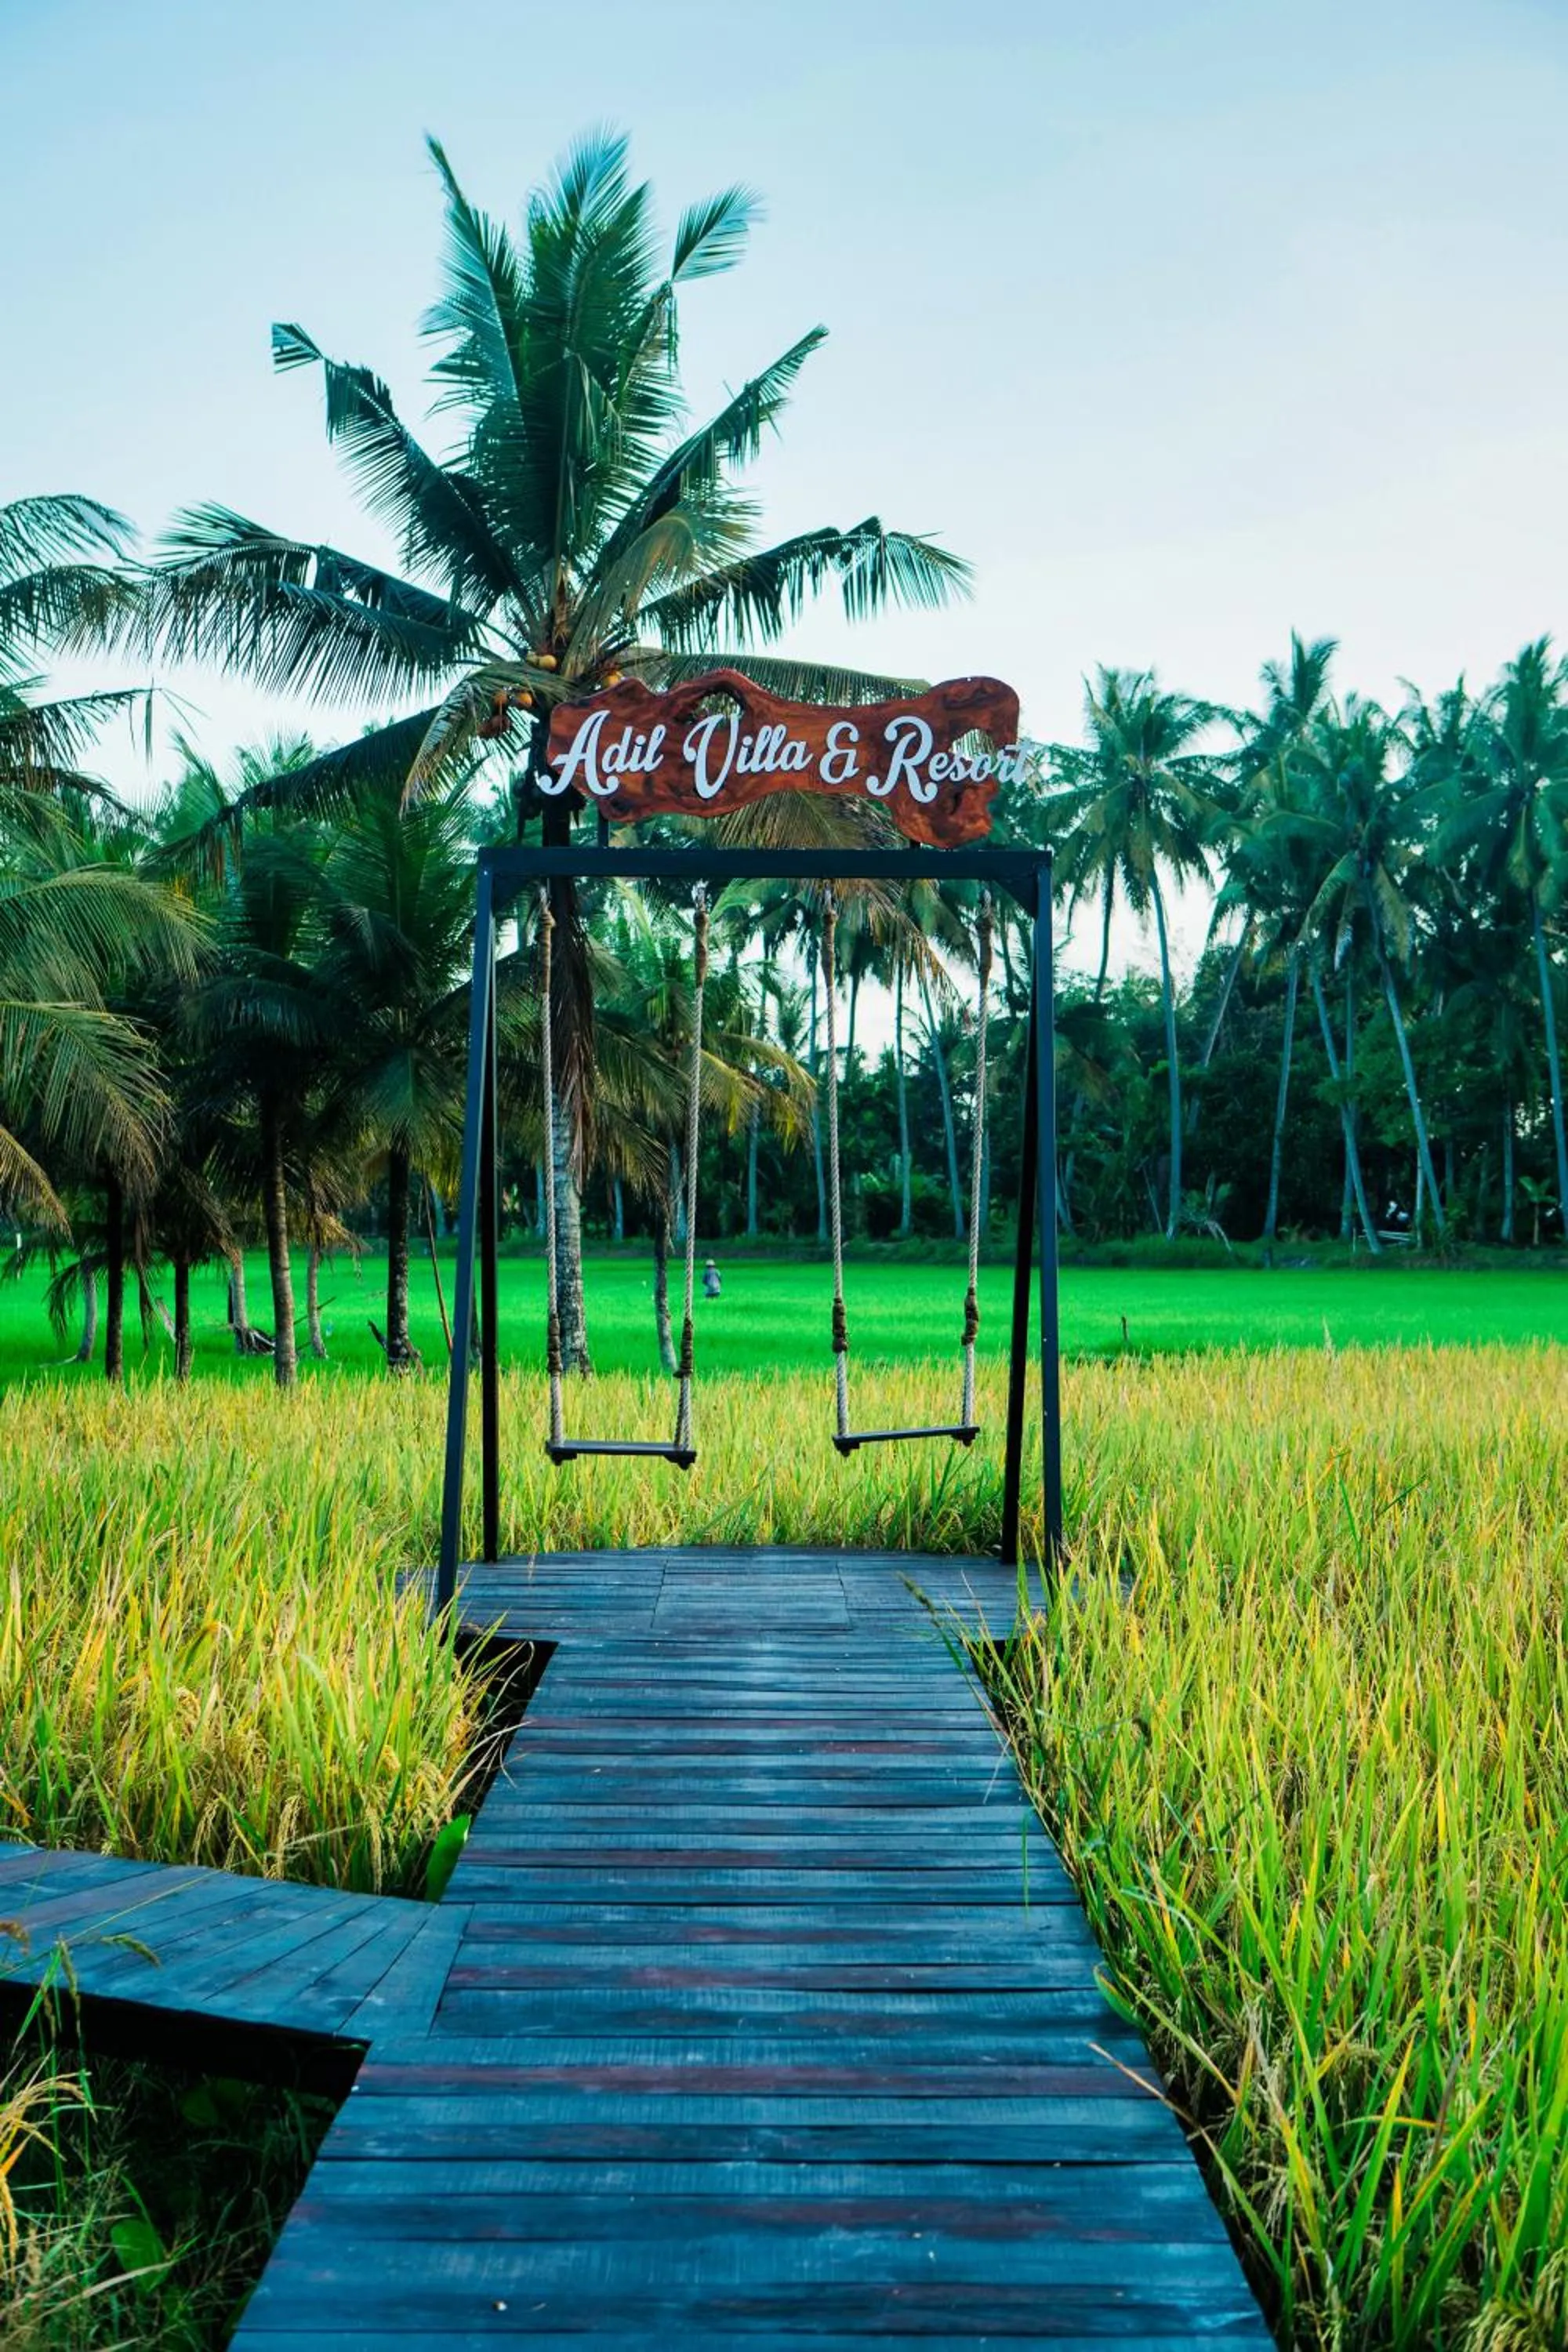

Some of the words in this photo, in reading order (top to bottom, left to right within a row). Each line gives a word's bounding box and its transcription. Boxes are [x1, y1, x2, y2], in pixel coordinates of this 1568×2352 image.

[537, 710, 666, 796] Adil
[682, 712, 814, 799] Villa
[819, 720, 861, 785] &
[866, 715, 1032, 804] Resort
